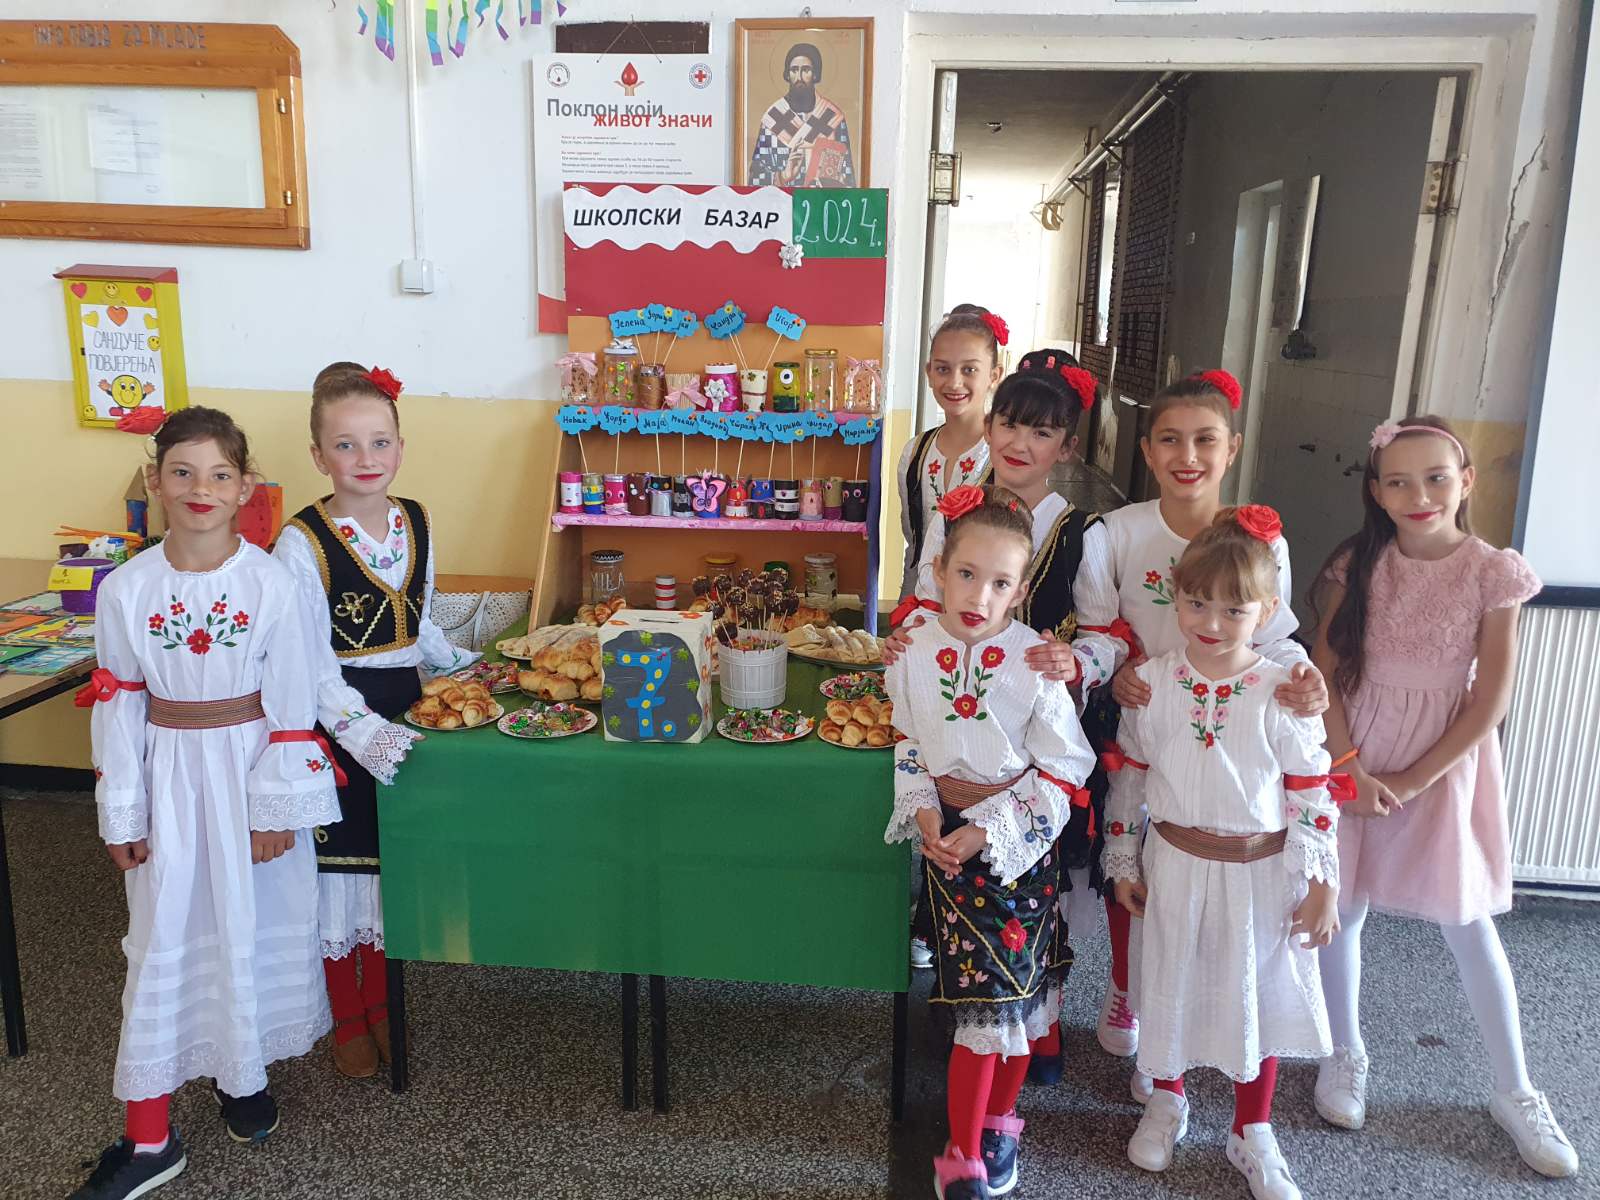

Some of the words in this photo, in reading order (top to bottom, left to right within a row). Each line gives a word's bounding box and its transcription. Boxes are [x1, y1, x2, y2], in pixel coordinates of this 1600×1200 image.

[149, 24, 207, 49] MLADE
[547, 98, 618, 117] Поклон
[625, 100, 663, 118] који
[593, 114, 651, 128] живот
[657, 114, 713, 128] значи
[573, 207, 682, 227] ШКОЛСКИ
[704, 208, 780, 229] БАЗАР
[795, 198, 882, 247] 2024.
[93, 330, 145, 351] САНДУЧЕ
[89, 354, 156, 374] ПОВЈЕРЕЊА
